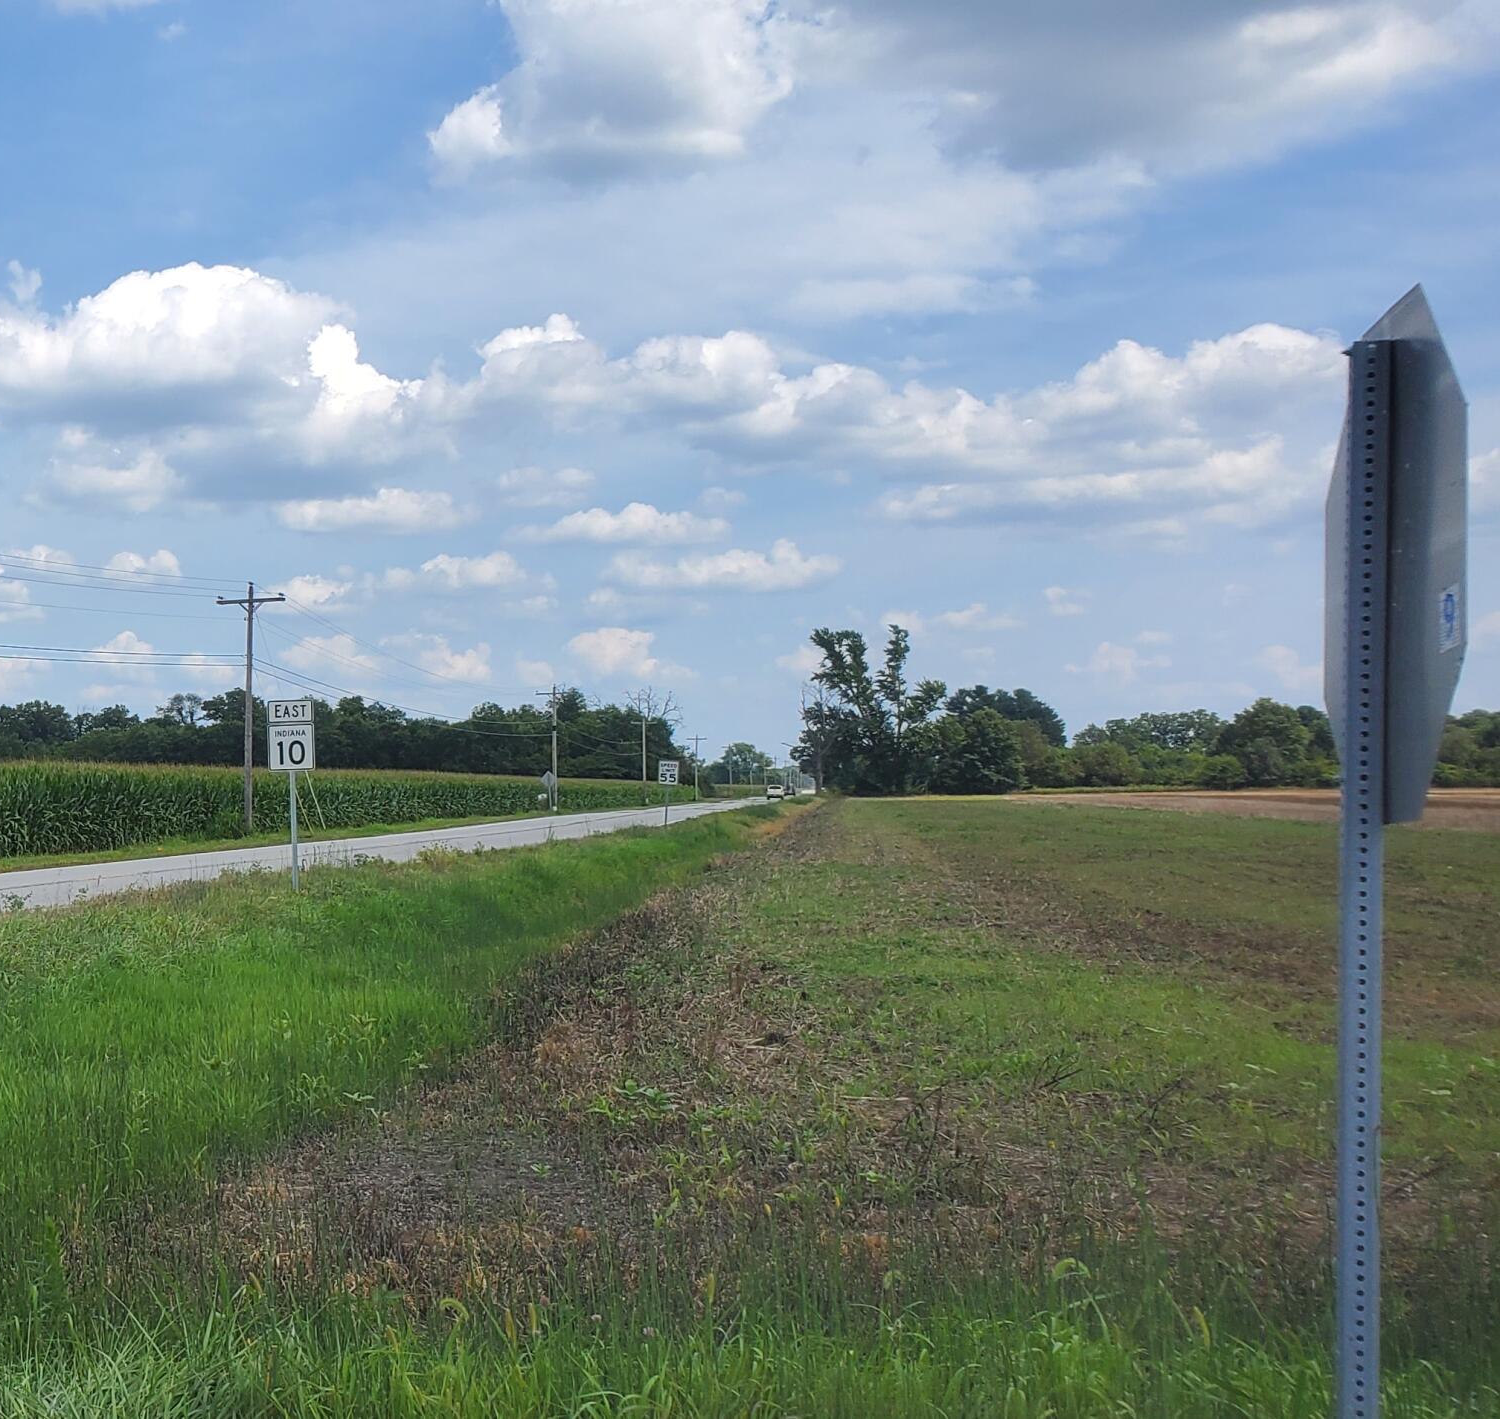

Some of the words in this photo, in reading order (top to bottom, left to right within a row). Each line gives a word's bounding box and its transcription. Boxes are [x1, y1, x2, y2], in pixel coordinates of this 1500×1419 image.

[275, 704, 307, 718] EAST
[277, 740, 305, 765] 10
[660, 773, 676, 783] 55
